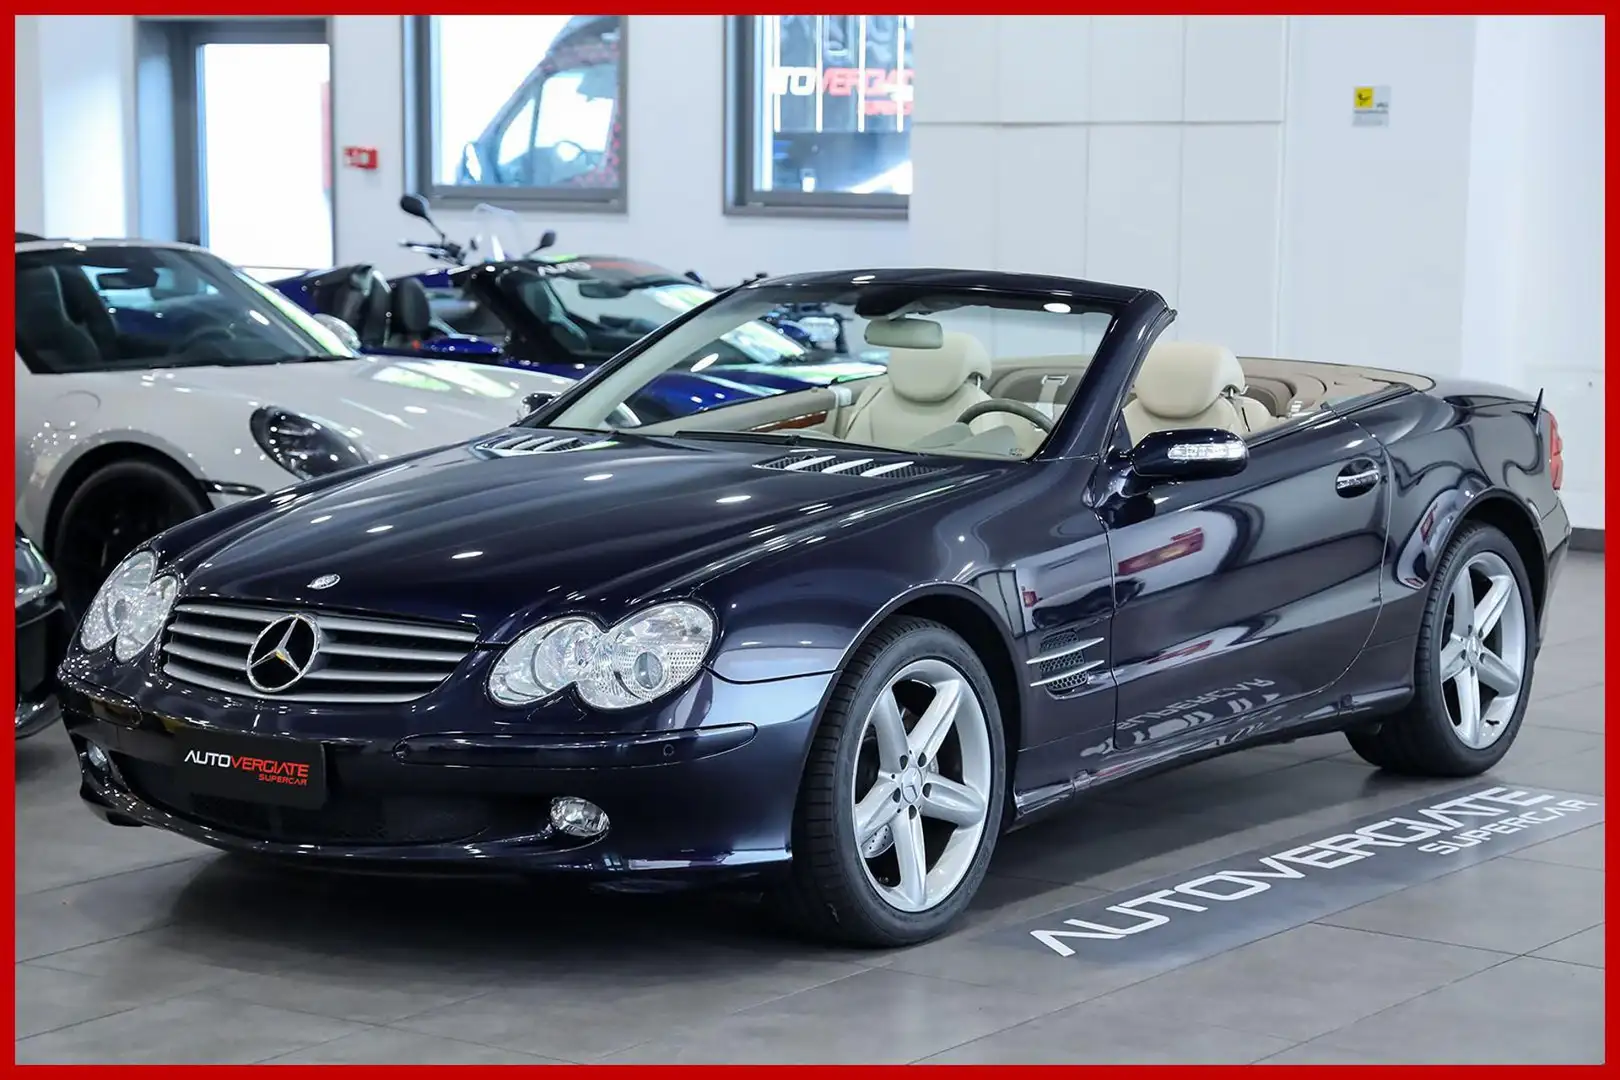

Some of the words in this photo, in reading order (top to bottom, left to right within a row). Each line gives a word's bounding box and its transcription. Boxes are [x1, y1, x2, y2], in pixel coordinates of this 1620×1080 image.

[184, 749, 310, 778] AUTOVERGIATE
[258, 773, 307, 786] SUPERCAR
[1417, 799, 1599, 855] SUPERCAR
[1029, 786, 1556, 957] AUTOVERGIATE
